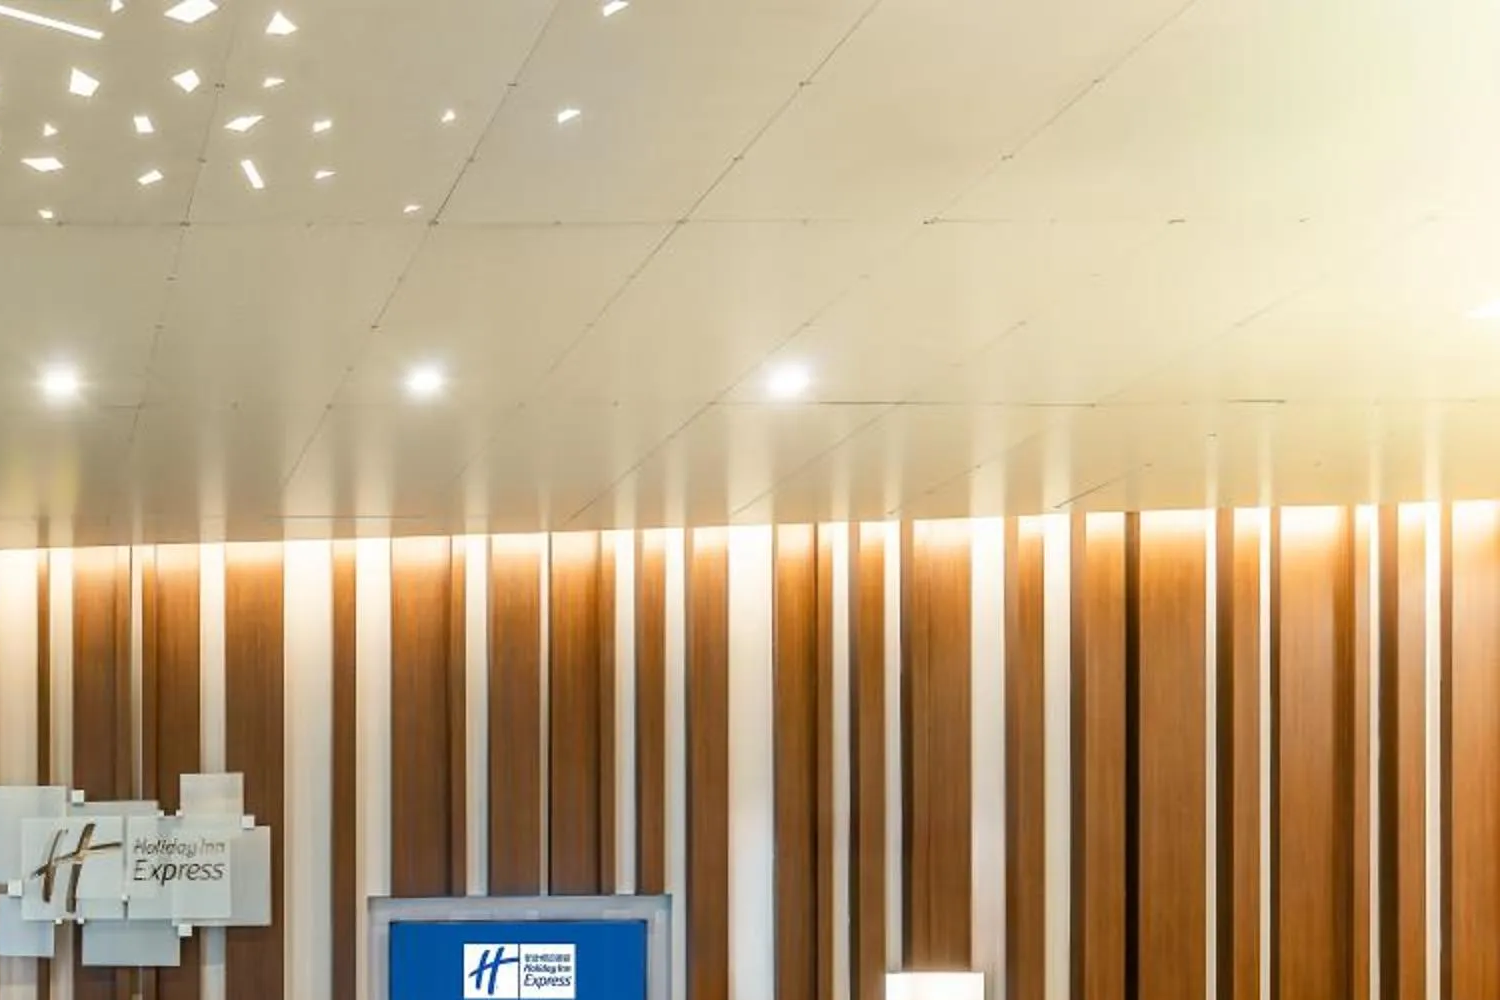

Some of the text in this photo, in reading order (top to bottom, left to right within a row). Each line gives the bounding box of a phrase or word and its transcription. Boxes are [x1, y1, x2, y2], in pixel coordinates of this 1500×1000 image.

[133, 837, 225, 858] Holiday Inn
[133, 859, 225, 887] Express
[524, 964, 556, 974] Holiday
[524, 974, 572, 989] Express
